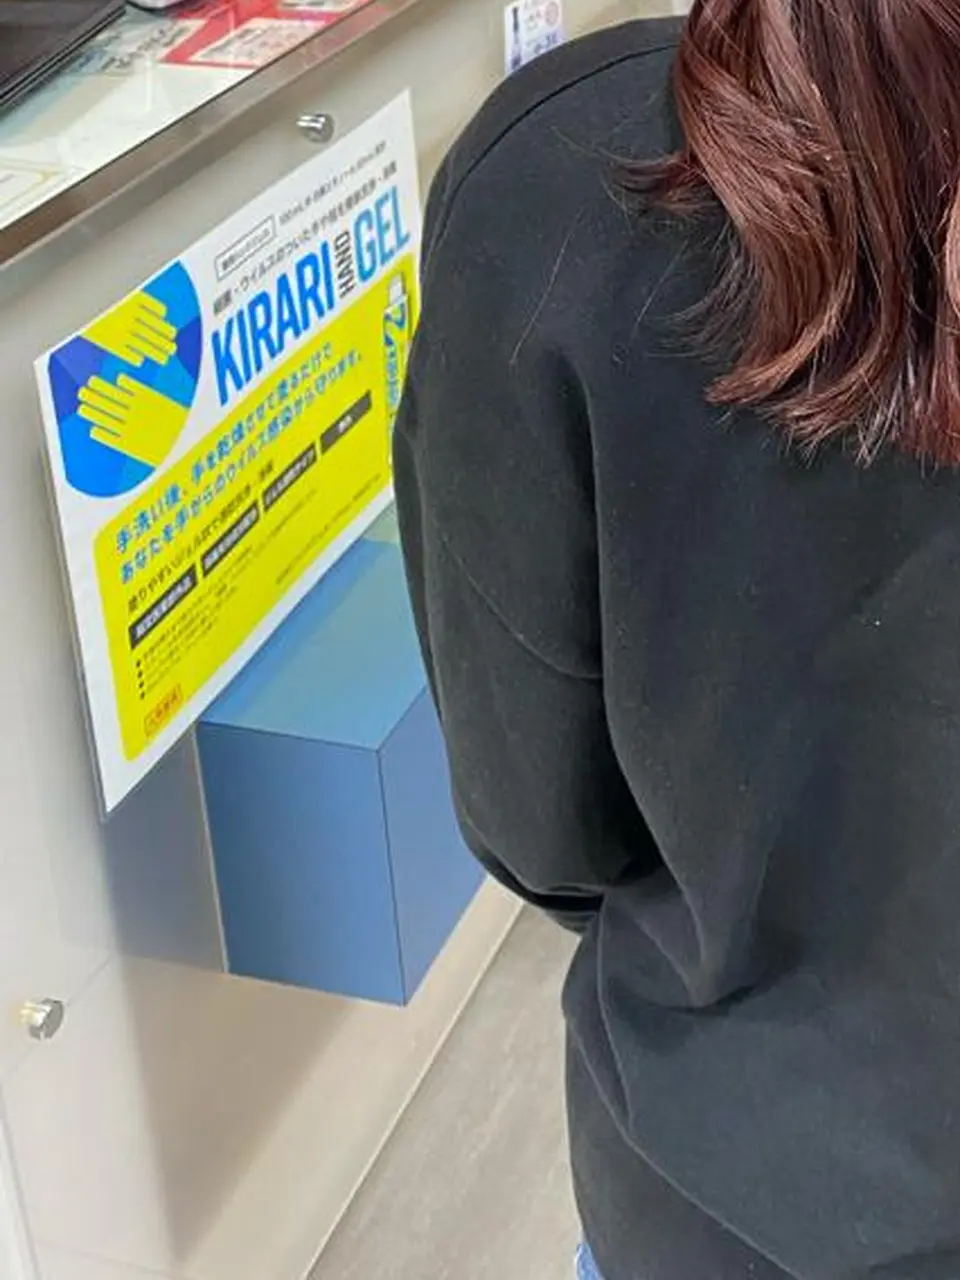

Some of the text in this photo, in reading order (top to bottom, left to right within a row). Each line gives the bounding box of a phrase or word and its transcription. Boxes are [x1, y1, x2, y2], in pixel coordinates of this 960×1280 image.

[211, 240, 335, 407] KIRARI
[334, 231, 358, 299] HAND
[353, 185, 410, 283] GEL
